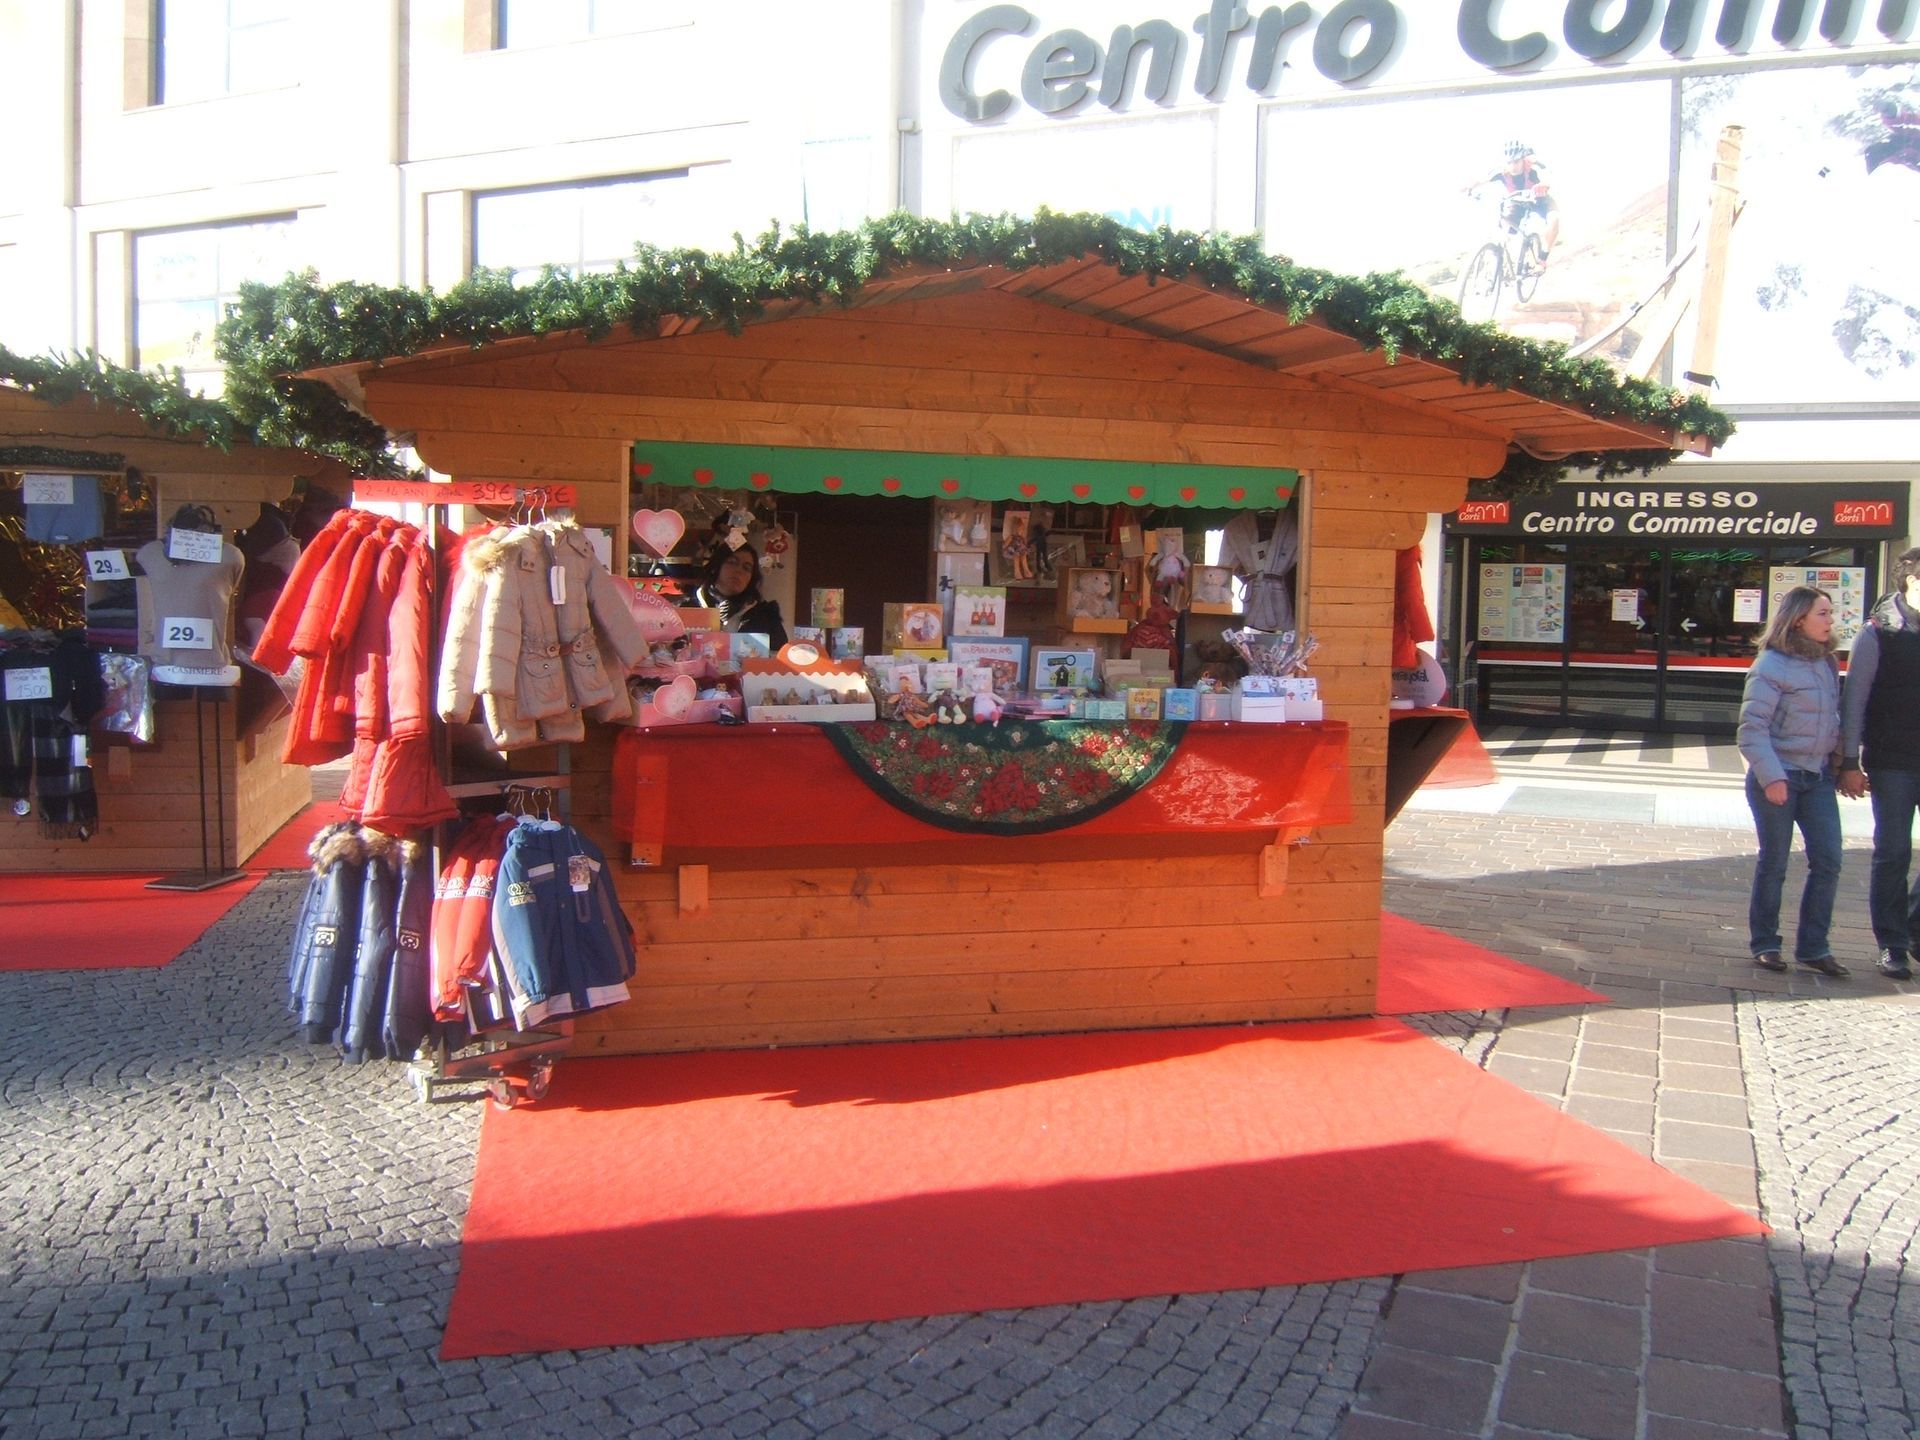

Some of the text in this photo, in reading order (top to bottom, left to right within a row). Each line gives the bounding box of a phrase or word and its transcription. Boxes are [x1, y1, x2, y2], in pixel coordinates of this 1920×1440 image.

[939, 0, 1399, 121] Centro
[472, 482, 513, 501] 39€
[1576, 491, 1758, 508] INGRESSO
[1522, 511, 1818, 535] Centro Commerciale
[171, 666, 223, 676] CASHMERE
